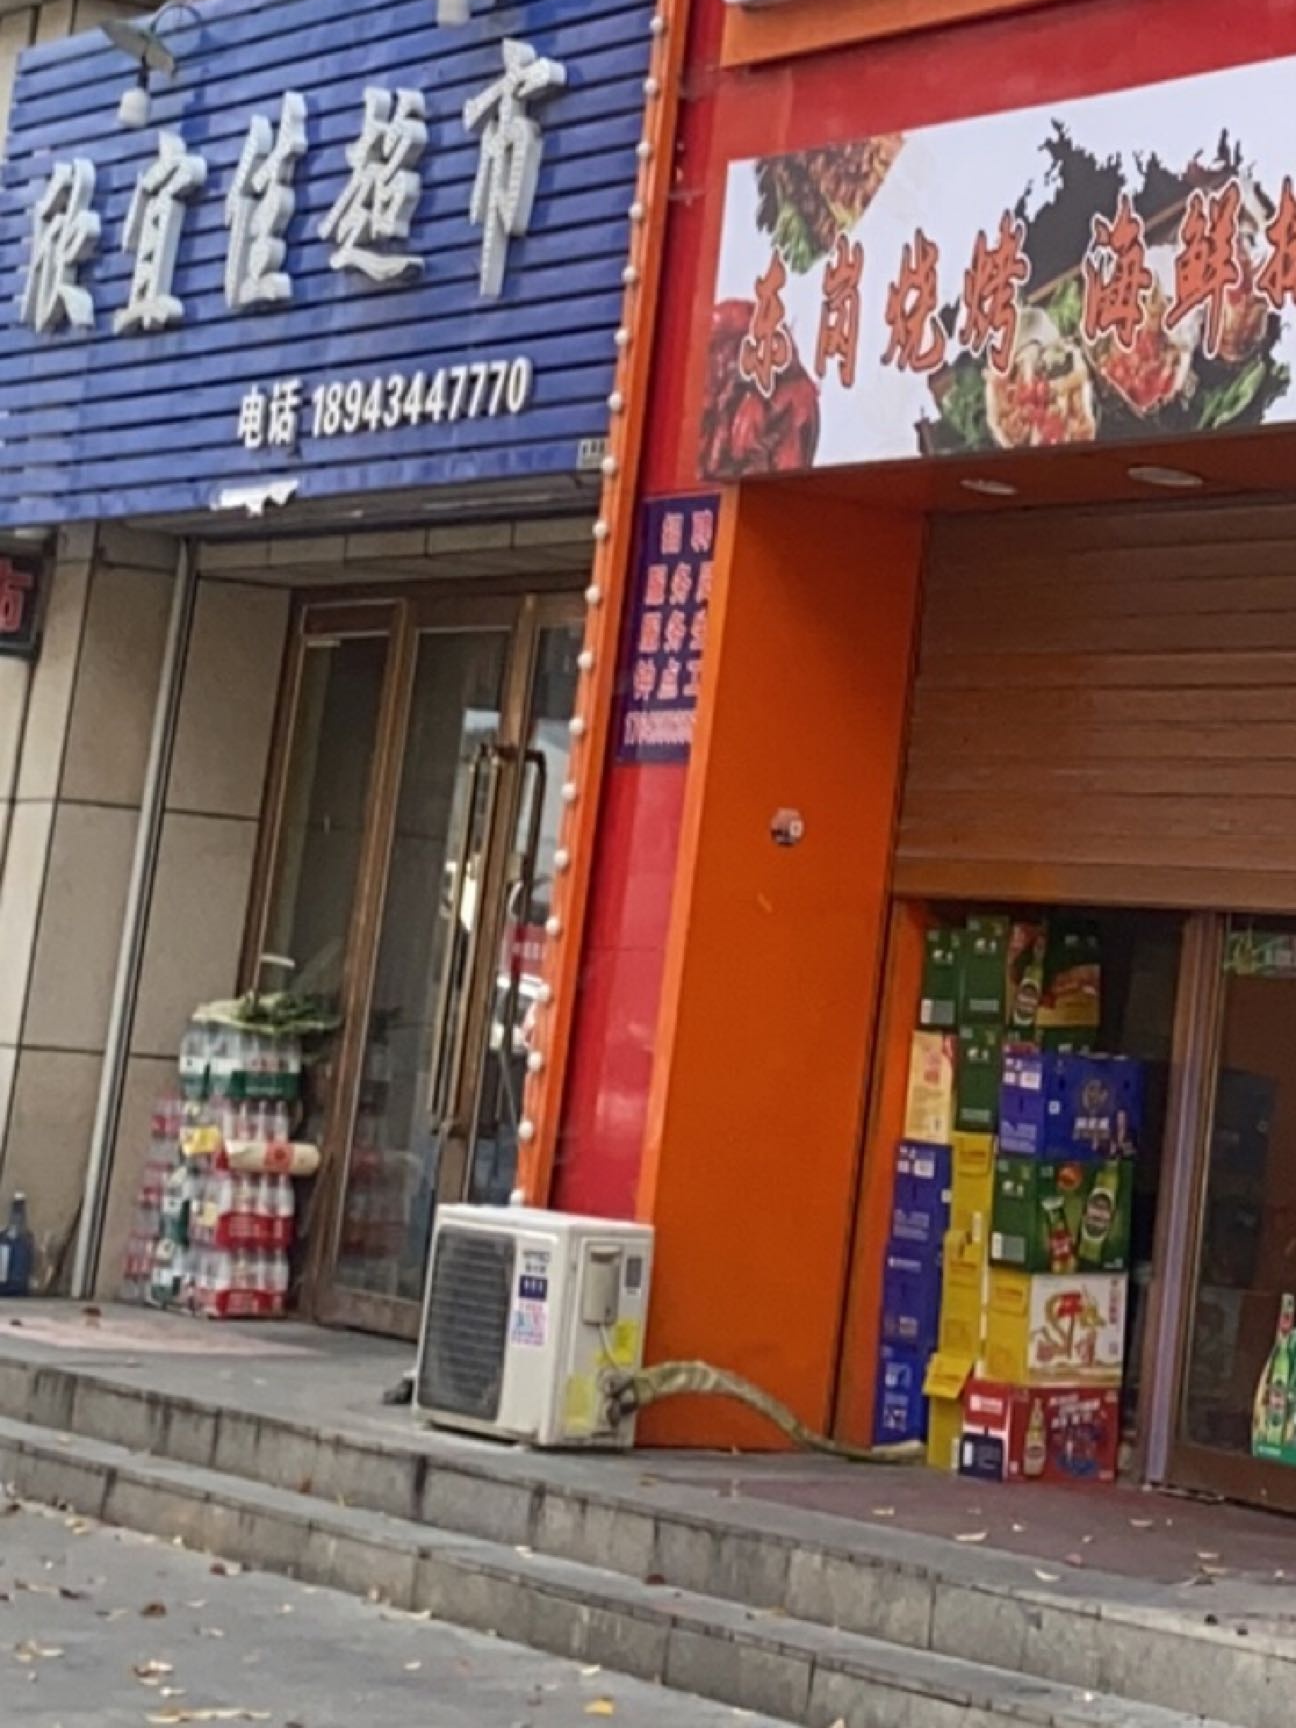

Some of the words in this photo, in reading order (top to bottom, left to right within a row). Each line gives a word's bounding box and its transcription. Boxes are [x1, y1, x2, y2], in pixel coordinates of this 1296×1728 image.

[20, 38, 567, 334] 欣宜佳超市
[238, 375, 303, 450] 电话
[311, 355, 533, 439] 18943447770
